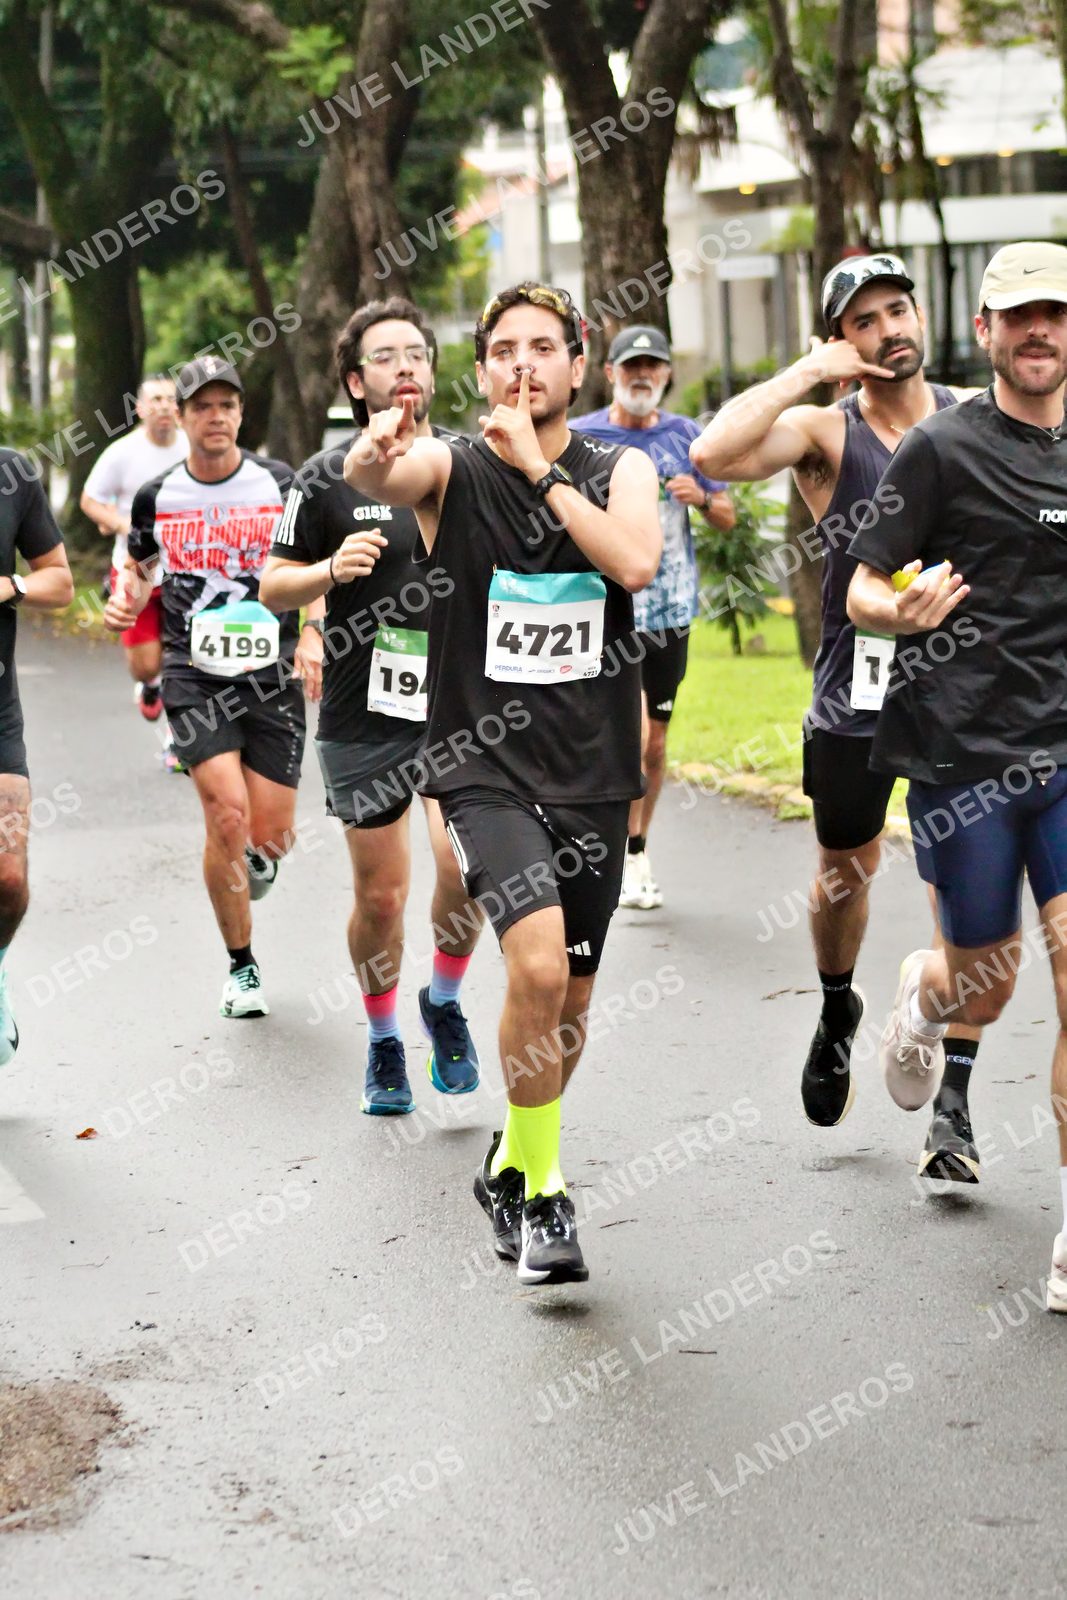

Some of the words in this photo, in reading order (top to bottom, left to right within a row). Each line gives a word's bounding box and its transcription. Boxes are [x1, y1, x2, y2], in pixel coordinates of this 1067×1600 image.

[199, 635, 271, 658] 4199
[496, 621, 590, 656] 4721
[379, 666, 427, 697] 19
[494, 665, 522, 673] PERDURA
